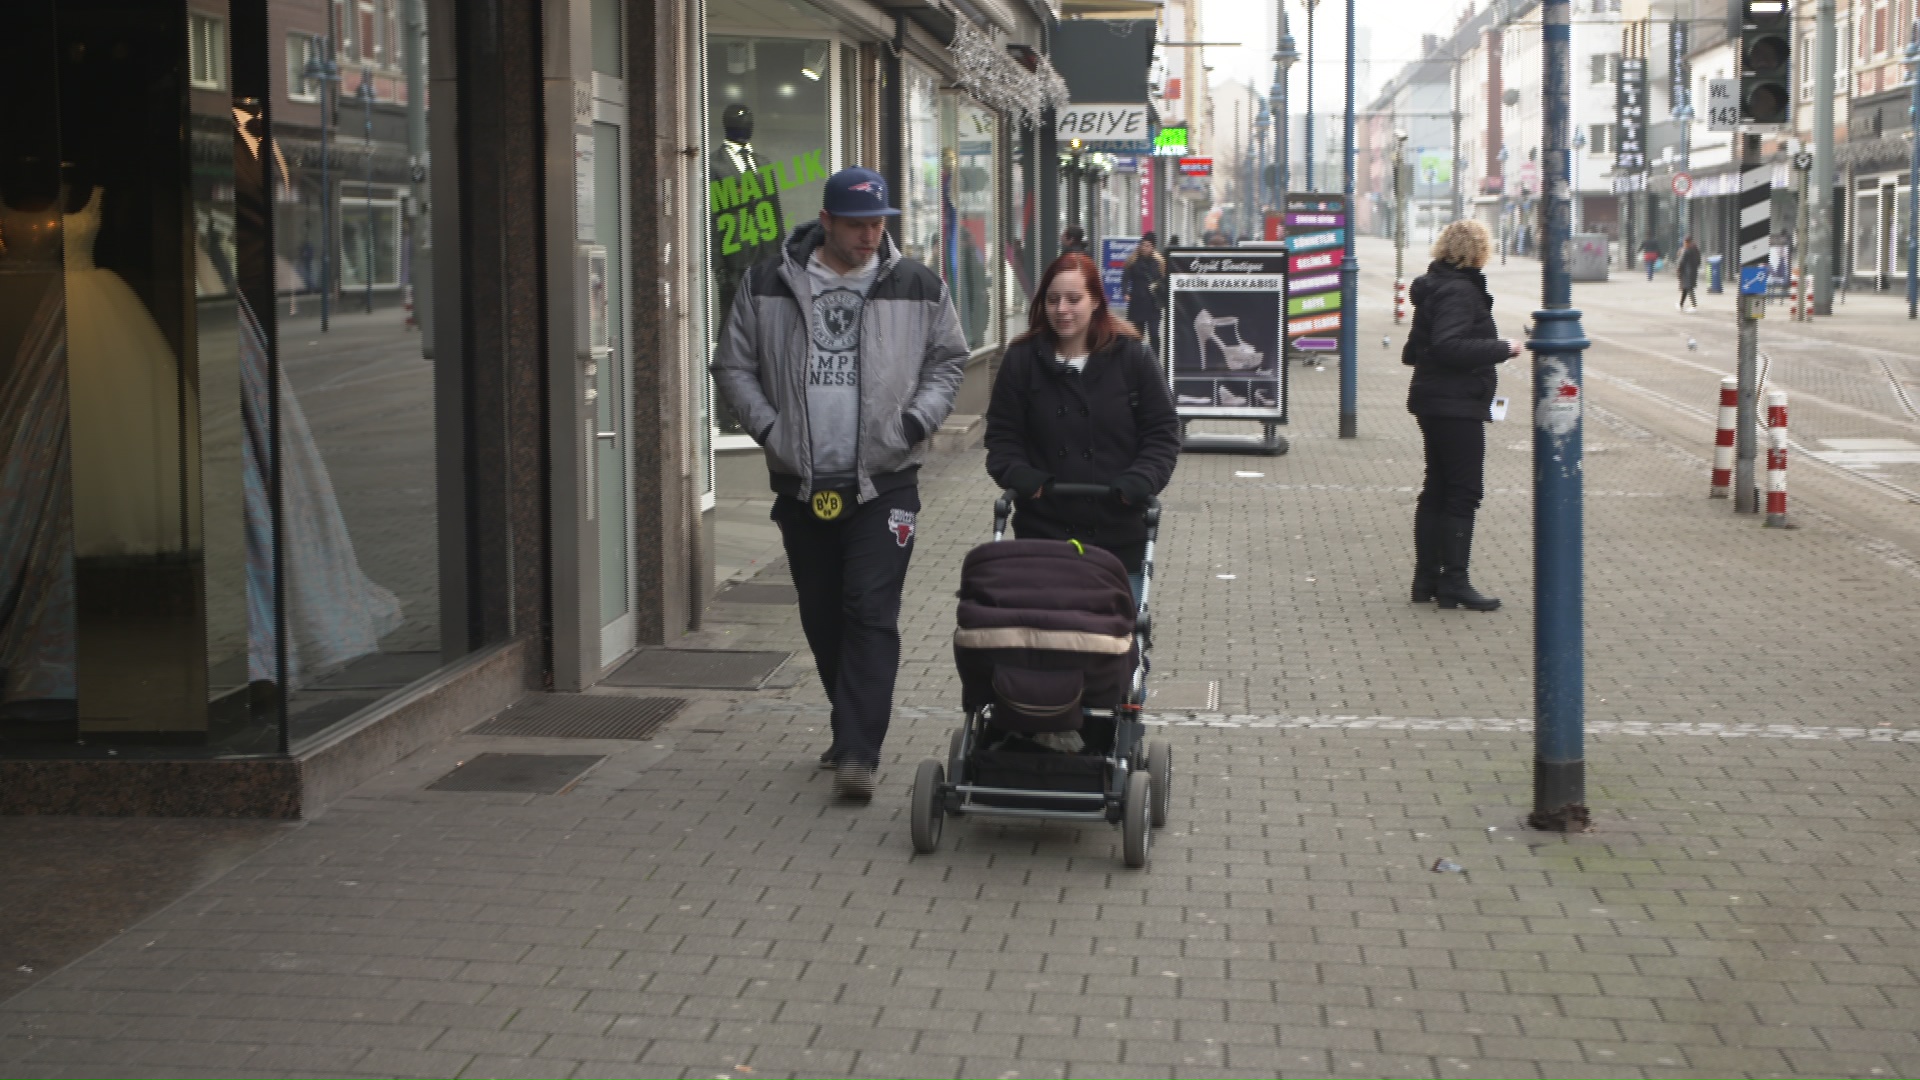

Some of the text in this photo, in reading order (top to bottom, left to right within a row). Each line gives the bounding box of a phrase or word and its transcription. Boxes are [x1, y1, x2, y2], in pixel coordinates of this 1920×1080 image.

[1710, 84, 1730, 98] WL
[1709, 106, 1737, 126] 143
[710, 148, 827, 213] MATLIK
[717, 200, 778, 256] 249
[1221, 258, 1264, 273] Boutique
[1211, 278, 1278, 288] AYAKKABISI
[816, 491, 838, 510] BVB
